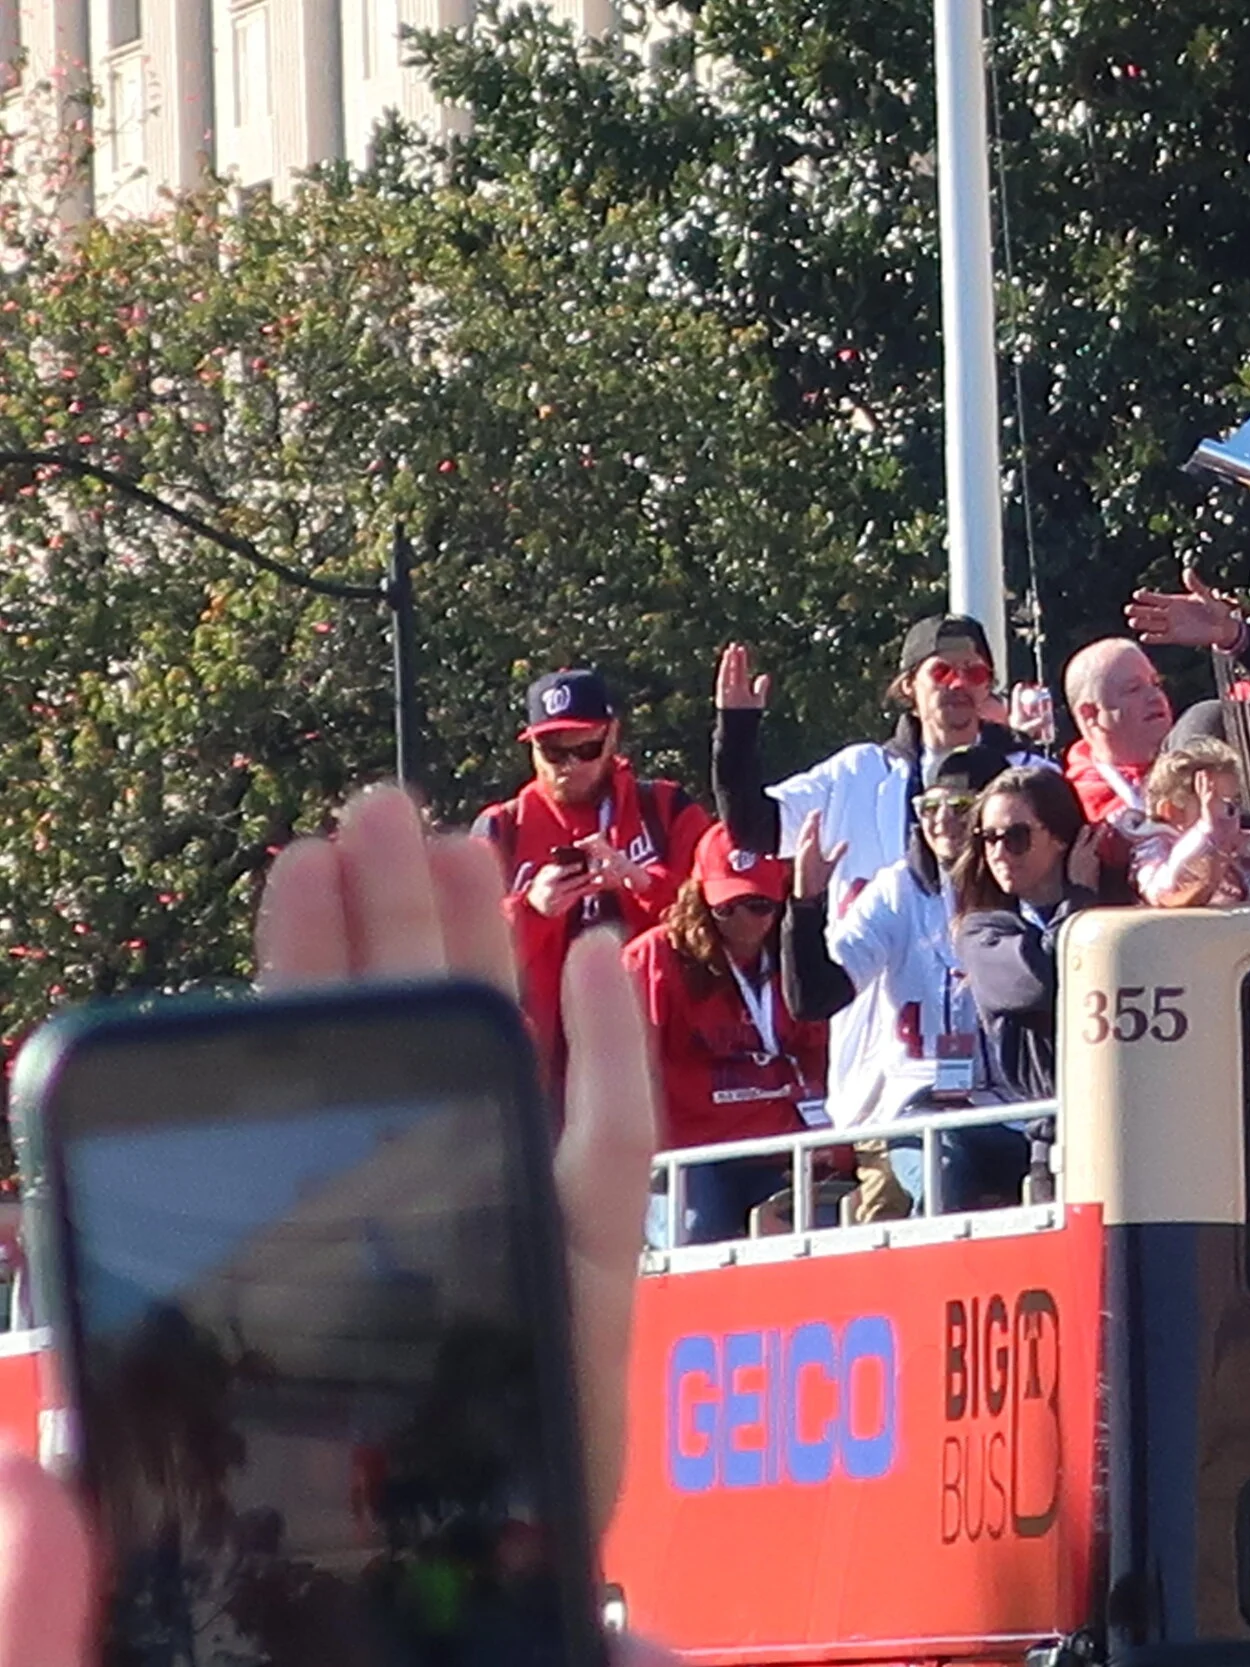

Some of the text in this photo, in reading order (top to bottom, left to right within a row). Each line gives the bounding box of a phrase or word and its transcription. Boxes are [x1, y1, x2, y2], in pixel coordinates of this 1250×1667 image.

[541, 684, 571, 716] W
[1082, 986, 1188, 1044] 355
[668, 1314, 898, 1491] GEICO
[946, 1294, 1009, 1420] BIG
[942, 1430, 1008, 1545] BUS
